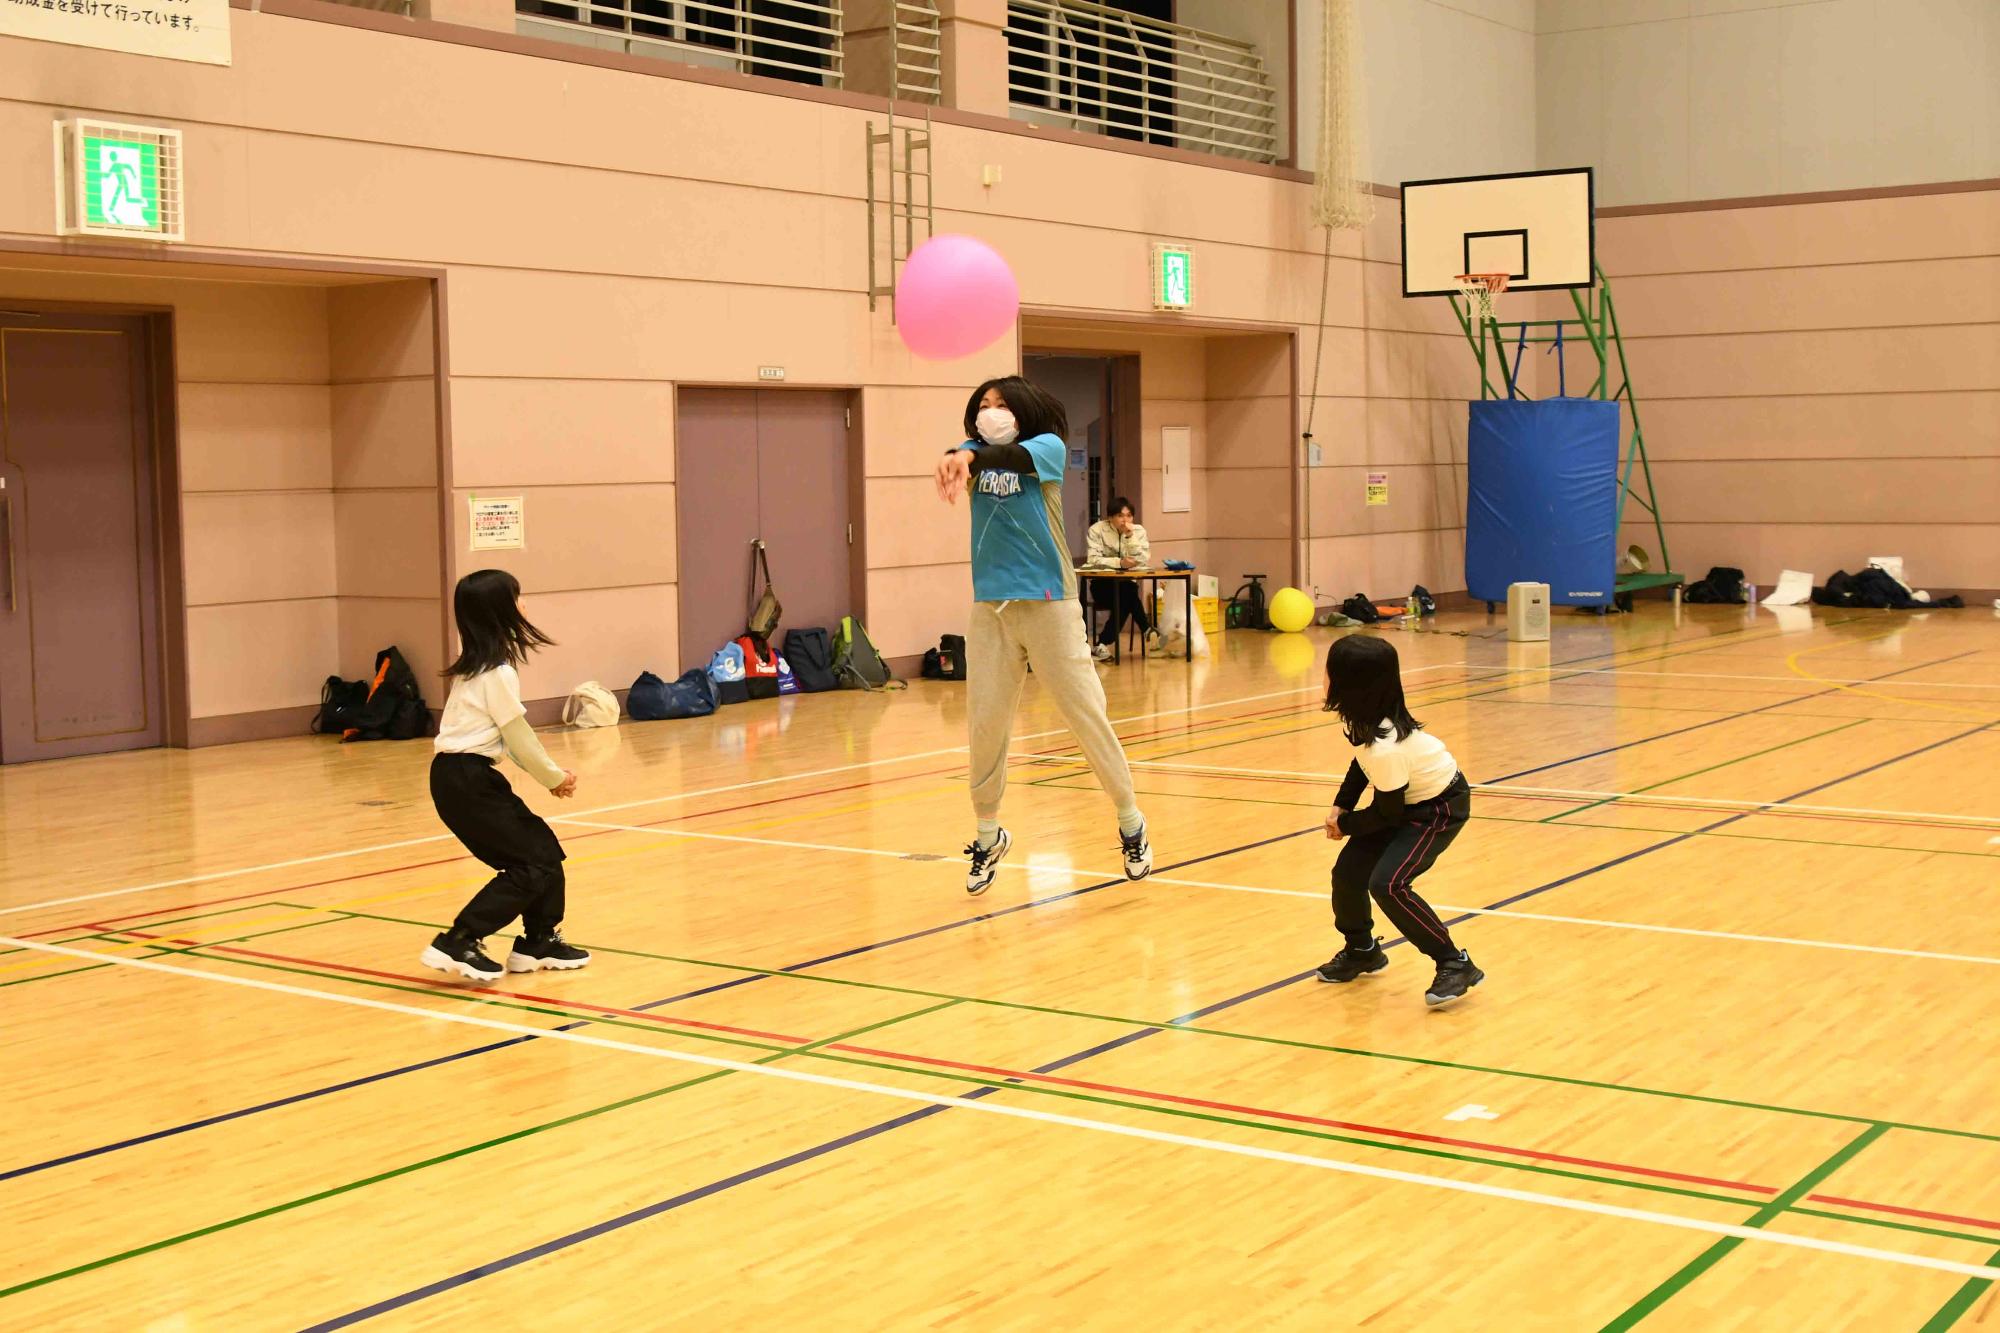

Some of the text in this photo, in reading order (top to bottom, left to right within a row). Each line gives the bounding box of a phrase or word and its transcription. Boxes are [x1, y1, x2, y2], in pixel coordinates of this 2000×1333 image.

[7, 0, 200, 33] 金を受けて行っています。
